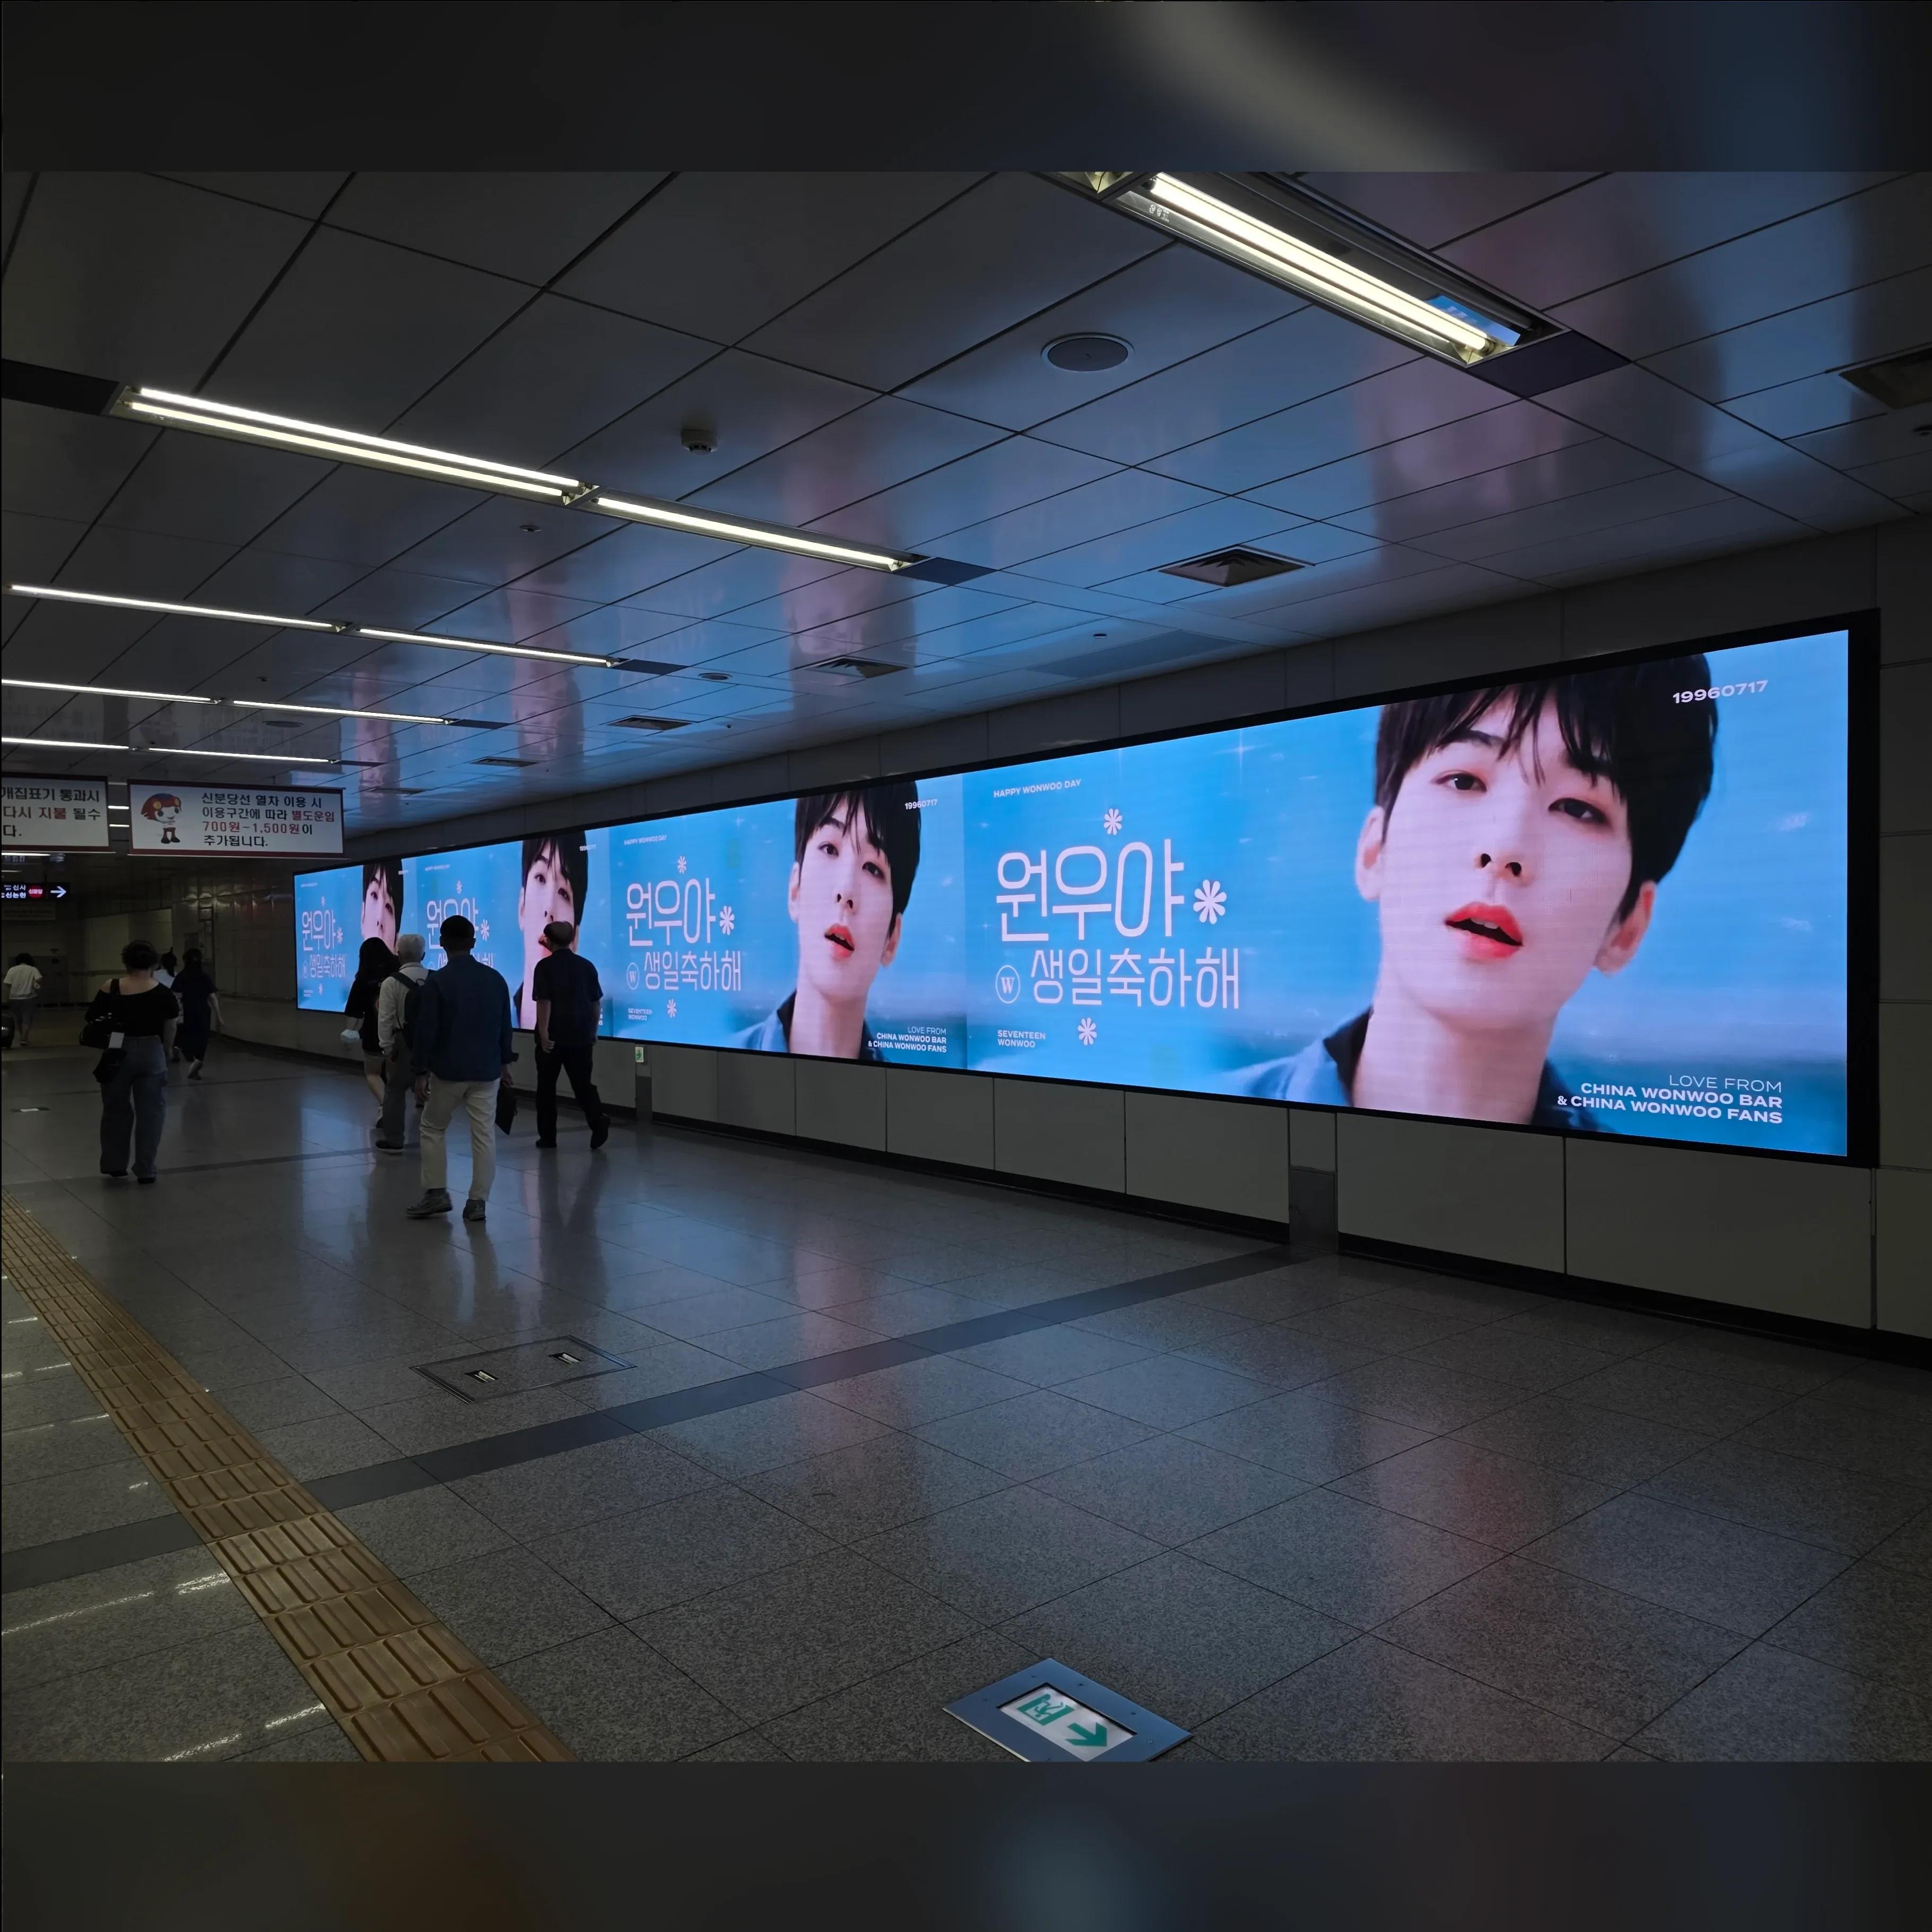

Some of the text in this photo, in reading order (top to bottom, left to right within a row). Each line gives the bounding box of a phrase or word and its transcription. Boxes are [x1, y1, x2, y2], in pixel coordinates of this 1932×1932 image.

[1673, 680, 1768, 704] 19960717
[59, 789, 99, 802] 통과시
[993, 779, 1082, 798] HAPPY WONWOO DAY
[202, 793, 321, 808] 신분당선 열차 이용 시
[905, 799, 938, 810] 19960717
[3, 806, 31, 819] 다시
[202, 806, 335, 822] 이용구간에 따라 별도운임
[3, 825, 22, 837] 다.
[204, 835, 268, 847] 추가됩니다.
[996, 839, 1185, 942] 원우야
[626, 878, 716, 946] 원우야
[302, 909, 336, 951] 원우야
[310, 954, 346, 977] 생일축하해
[644, 950, 741, 991] 생일축하해
[1031, 947, 1239, 1009] 생일축하해
[898, 1034, 930, 1043] WONWOO
[998, 1029, 1045, 1040] SEVENTEEN
[895, 1042, 926, 1051] WONWOO
[998, 1039, 1035, 1048] WONWOO
[1670, 1074, 1782, 1093] LOVE FROM
[1581, 1083, 1782, 1109] CHINA WONWOO BAR
[1557, 1095, 1783, 1125] & CHINA WONWOO FANS
